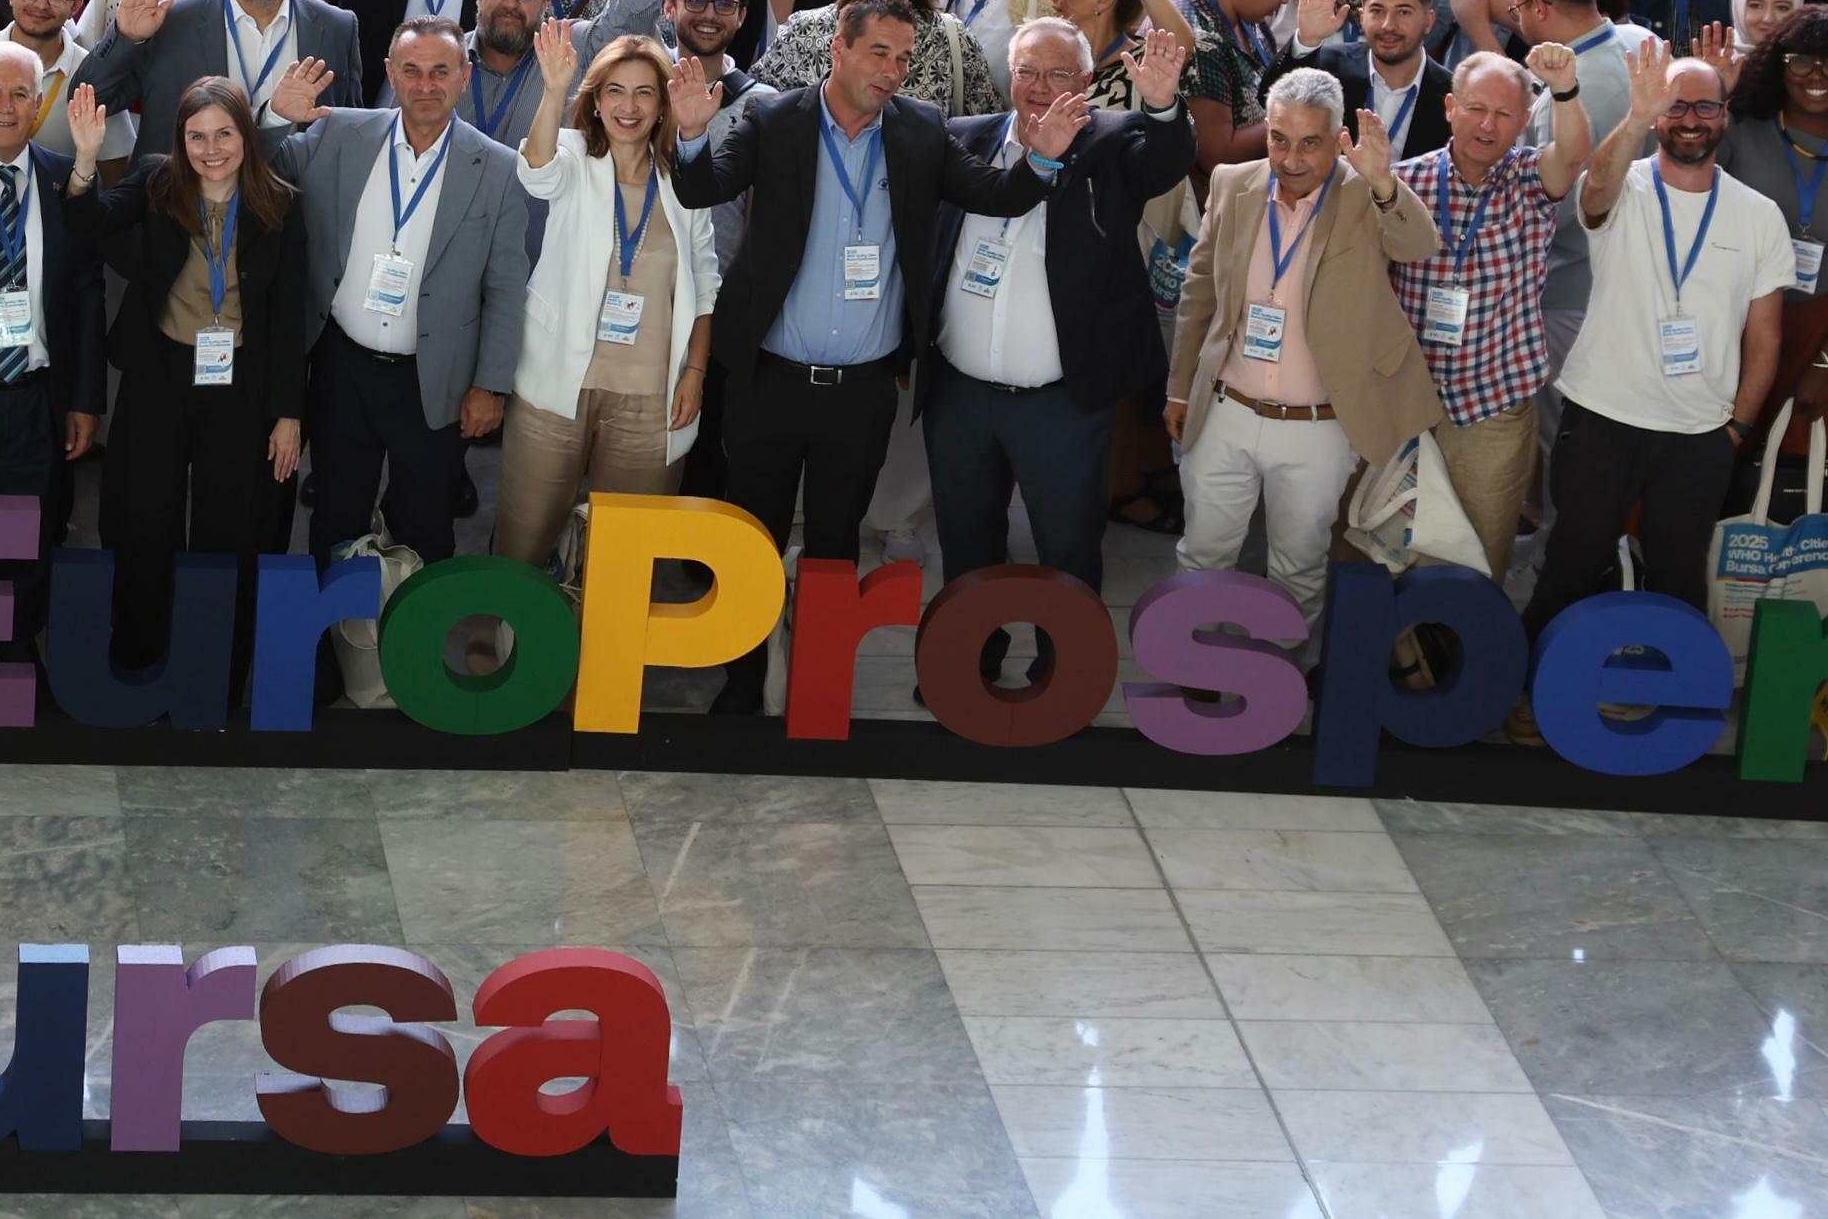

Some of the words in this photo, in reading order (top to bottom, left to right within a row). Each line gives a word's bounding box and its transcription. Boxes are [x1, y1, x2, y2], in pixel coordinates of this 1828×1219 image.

[1728, 533, 1769, 550] 2025
[1728, 549, 1762, 562] WHO
[1725, 559, 1766, 574] Bursa
